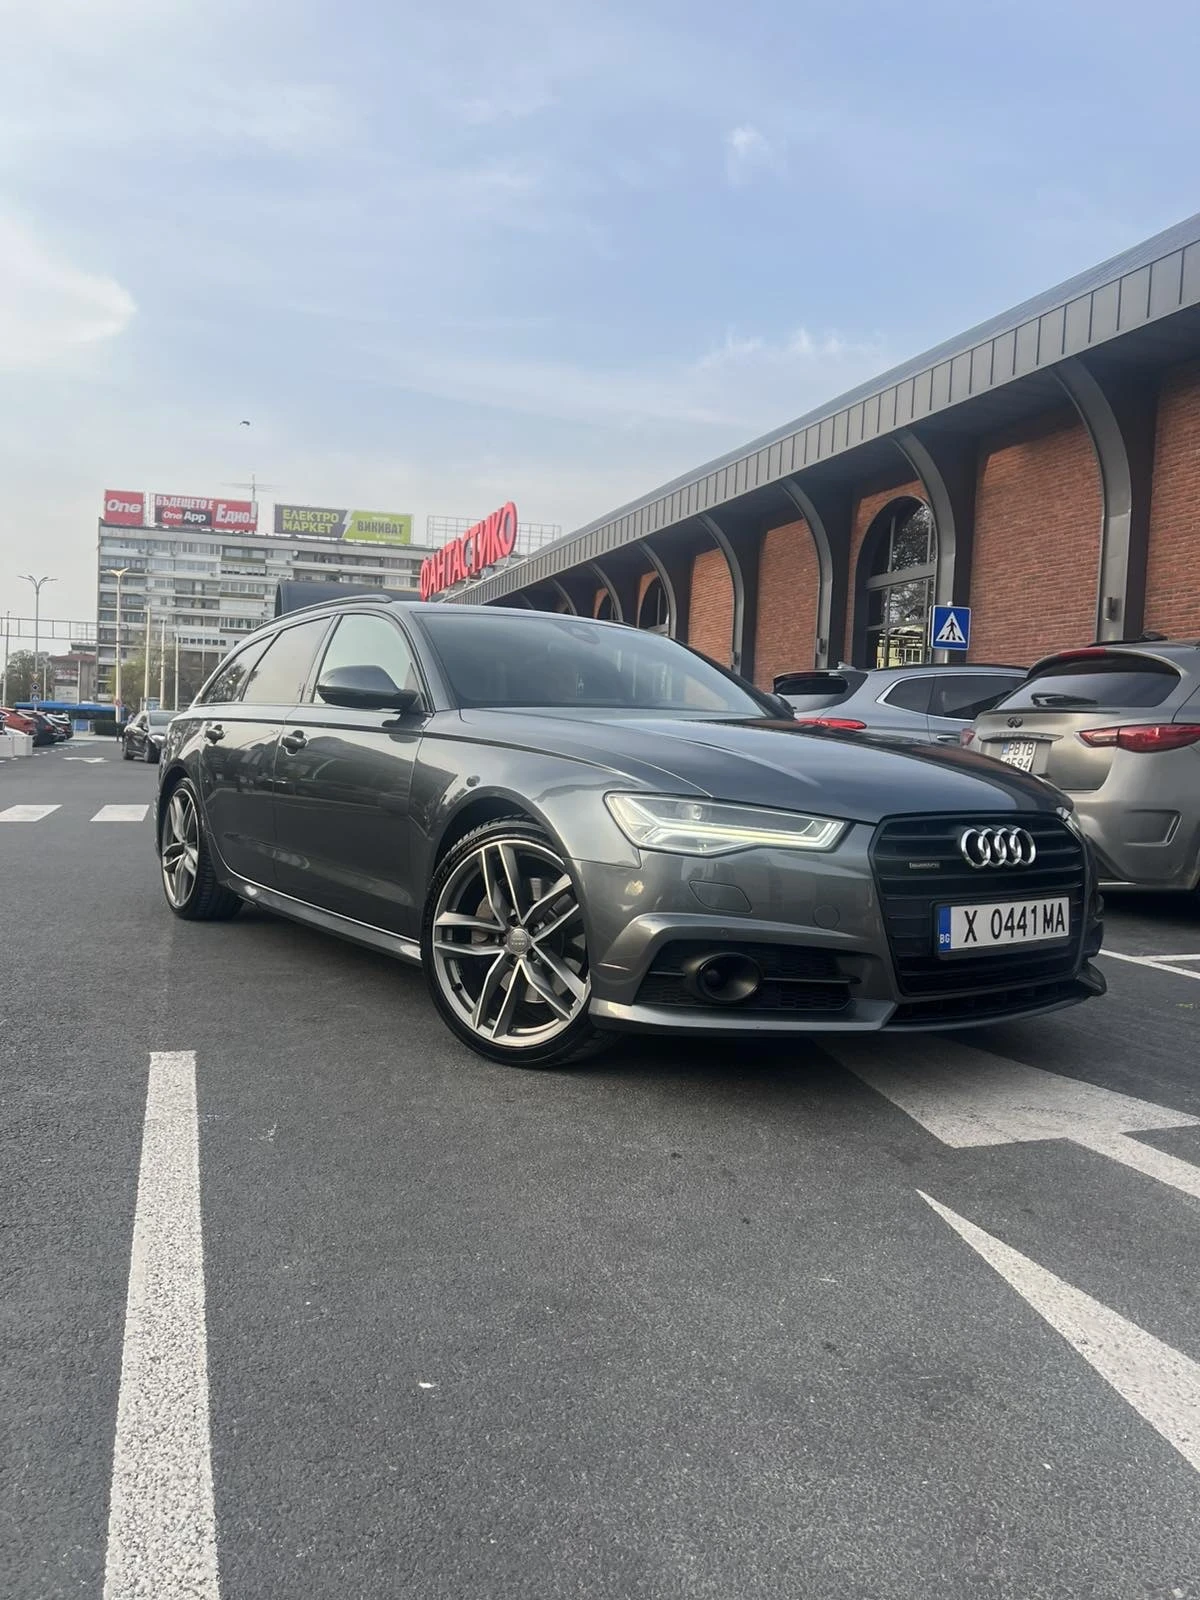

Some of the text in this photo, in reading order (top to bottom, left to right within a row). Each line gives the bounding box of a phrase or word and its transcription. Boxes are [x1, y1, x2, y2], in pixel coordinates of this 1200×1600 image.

[107, 499, 142, 513] One
[156, 495, 208, 510] БЪДЕЩЕТО
[163, 509, 207, 523] One App
[282, 509, 339, 523] ЕЛЕКТРО
[282, 521, 334, 533] МАРКЕТ
[357, 520, 404, 535] ВИКИВАТ
[420, 501, 518, 602] ФАНТАСТИКО
[964, 909, 978, 943] X
[939, 934, 951, 944] BG
